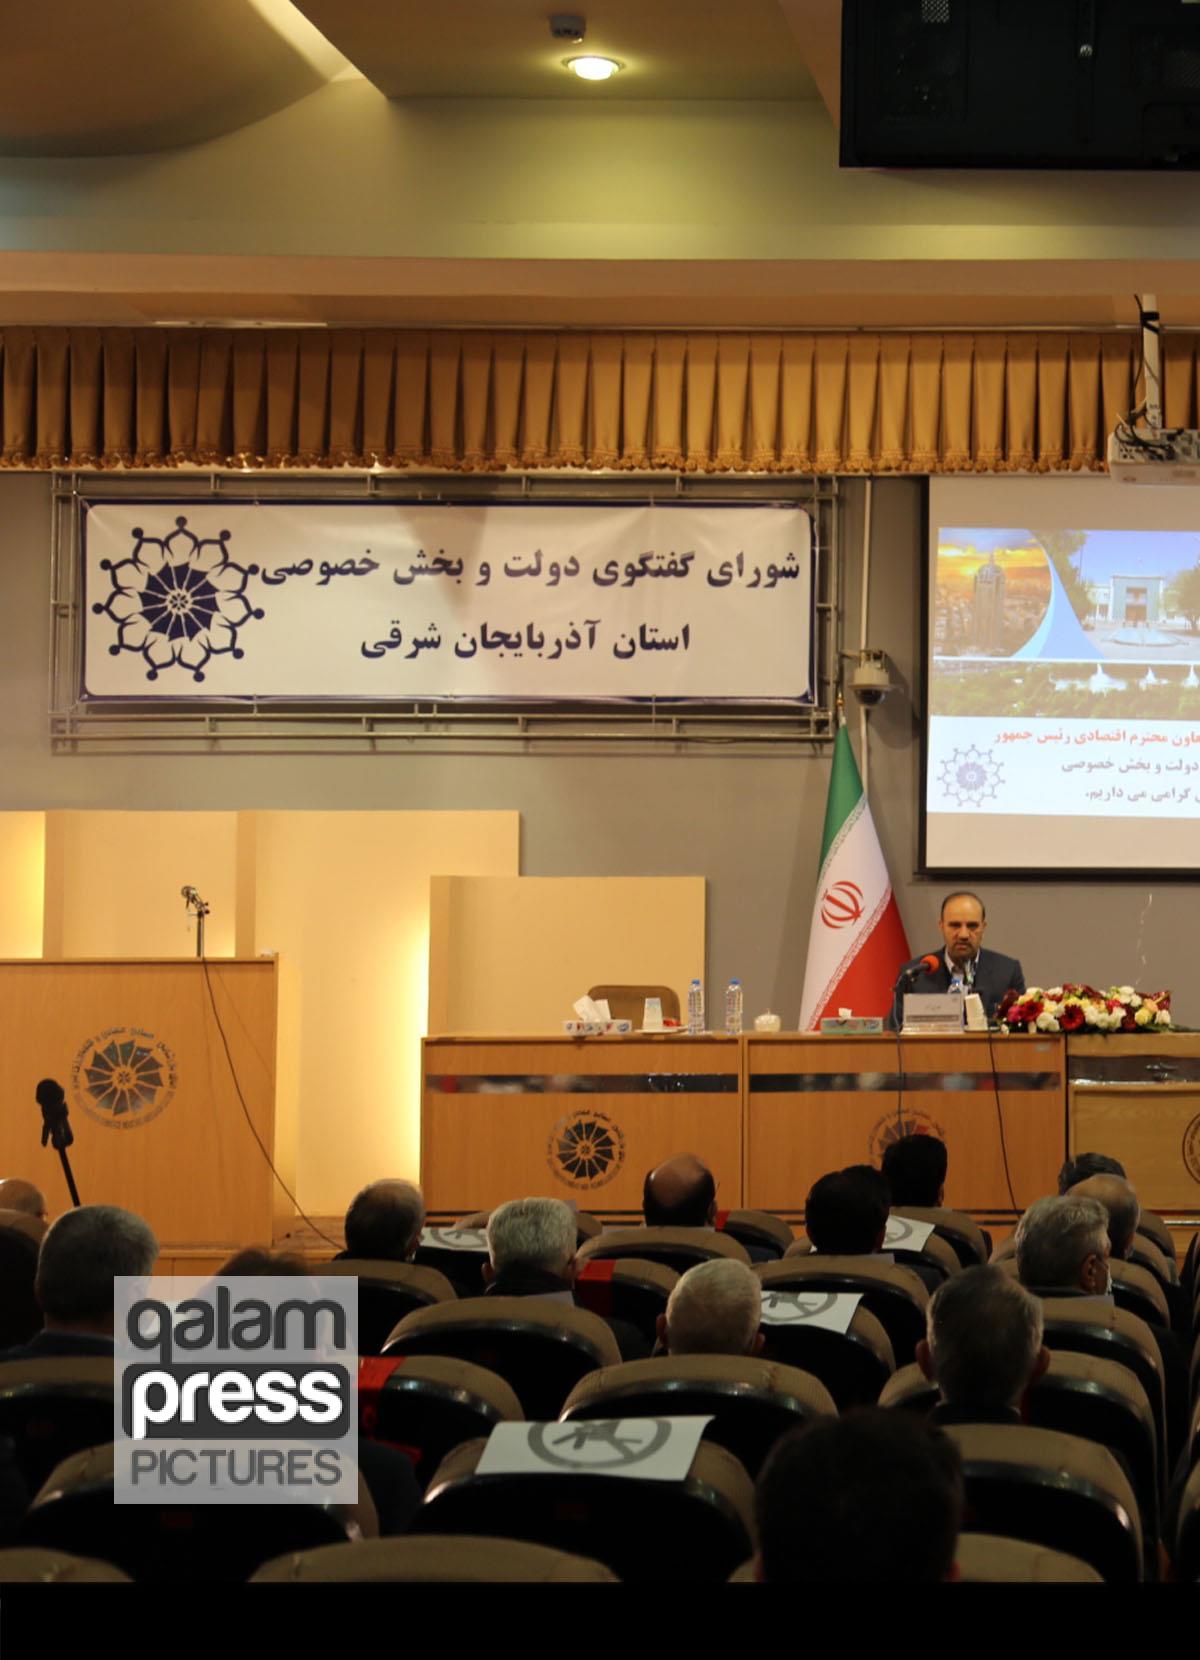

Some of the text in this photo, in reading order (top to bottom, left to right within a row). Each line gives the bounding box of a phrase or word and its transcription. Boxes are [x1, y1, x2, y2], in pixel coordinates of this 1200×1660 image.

[261, 549, 800, 588] شورای گفتگوی دولت و بخش خصوصی
[361, 619, 690, 659] استان آذربایجان شرقی
